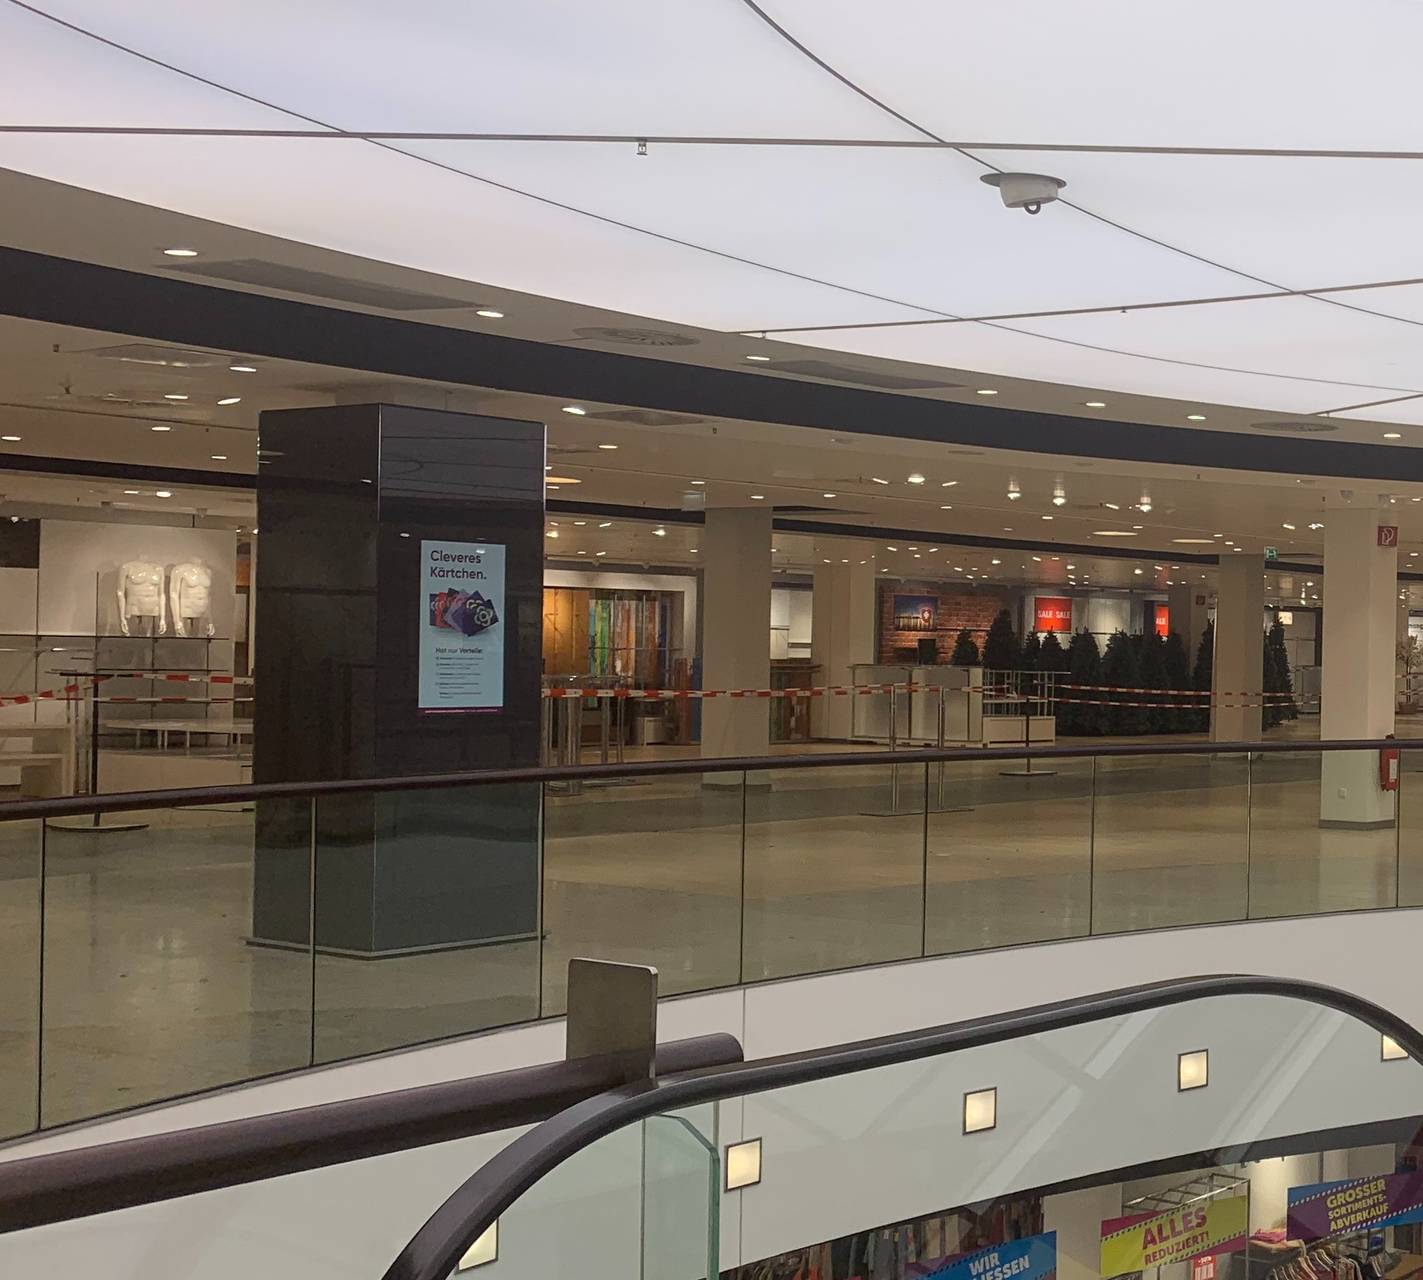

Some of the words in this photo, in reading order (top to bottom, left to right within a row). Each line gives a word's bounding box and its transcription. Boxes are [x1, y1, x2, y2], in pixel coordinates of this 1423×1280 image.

[430, 550, 482, 564] Cleveres
[430, 566, 487, 580] Kärtchen.
[1038, 610, 1054, 619] SALE
[1055, 610, 1072, 619] SALE
[1326, 1179, 1386, 1208] GROSSER
[1328, 1193, 1387, 1220] SORTIMENTS-
[1142, 1206, 1208, 1250] ALLES
[1329, 1203, 1389, 1232] ABVERKAUF
[1144, 1230, 1210, 1265] REDUZIERT!
[968, 1252, 1000, 1276] WIR
